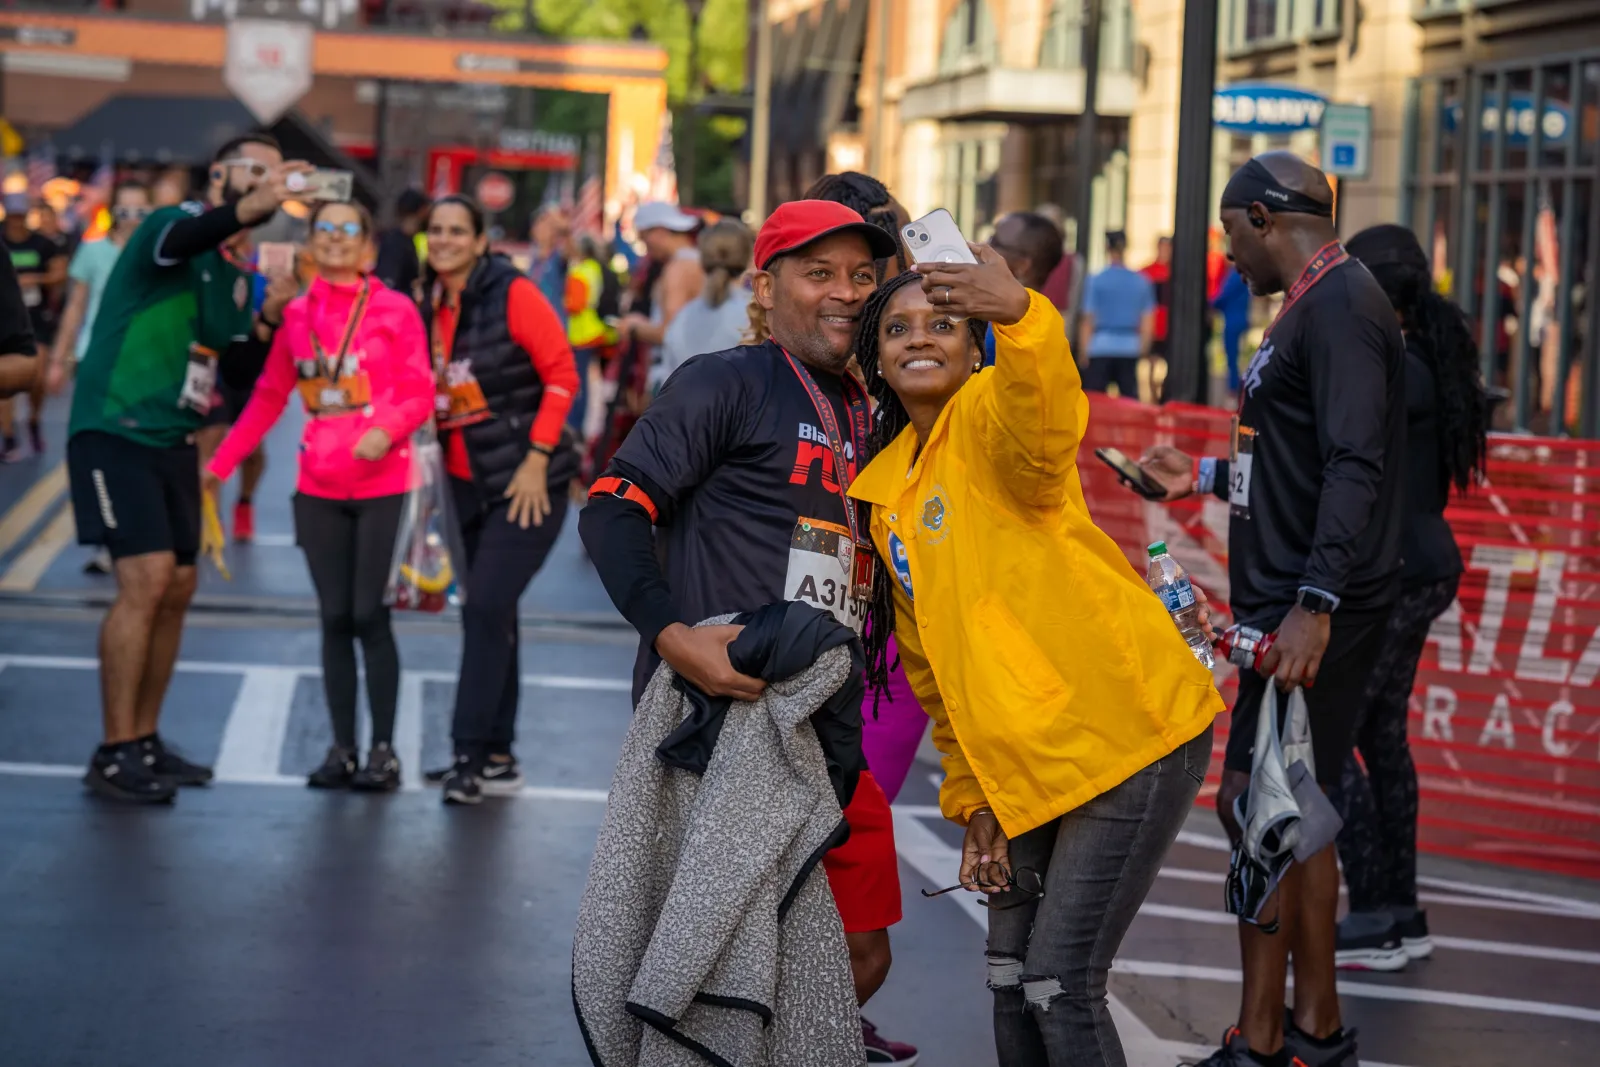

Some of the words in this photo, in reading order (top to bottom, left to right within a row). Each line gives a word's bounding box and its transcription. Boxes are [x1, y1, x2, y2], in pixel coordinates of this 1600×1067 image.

[1256, 97, 1325, 126] NAVY
[812, 383, 835, 432] ATLANTA
[833, 440, 840, 453] 10
[855, 411, 866, 457] ATLANTA
